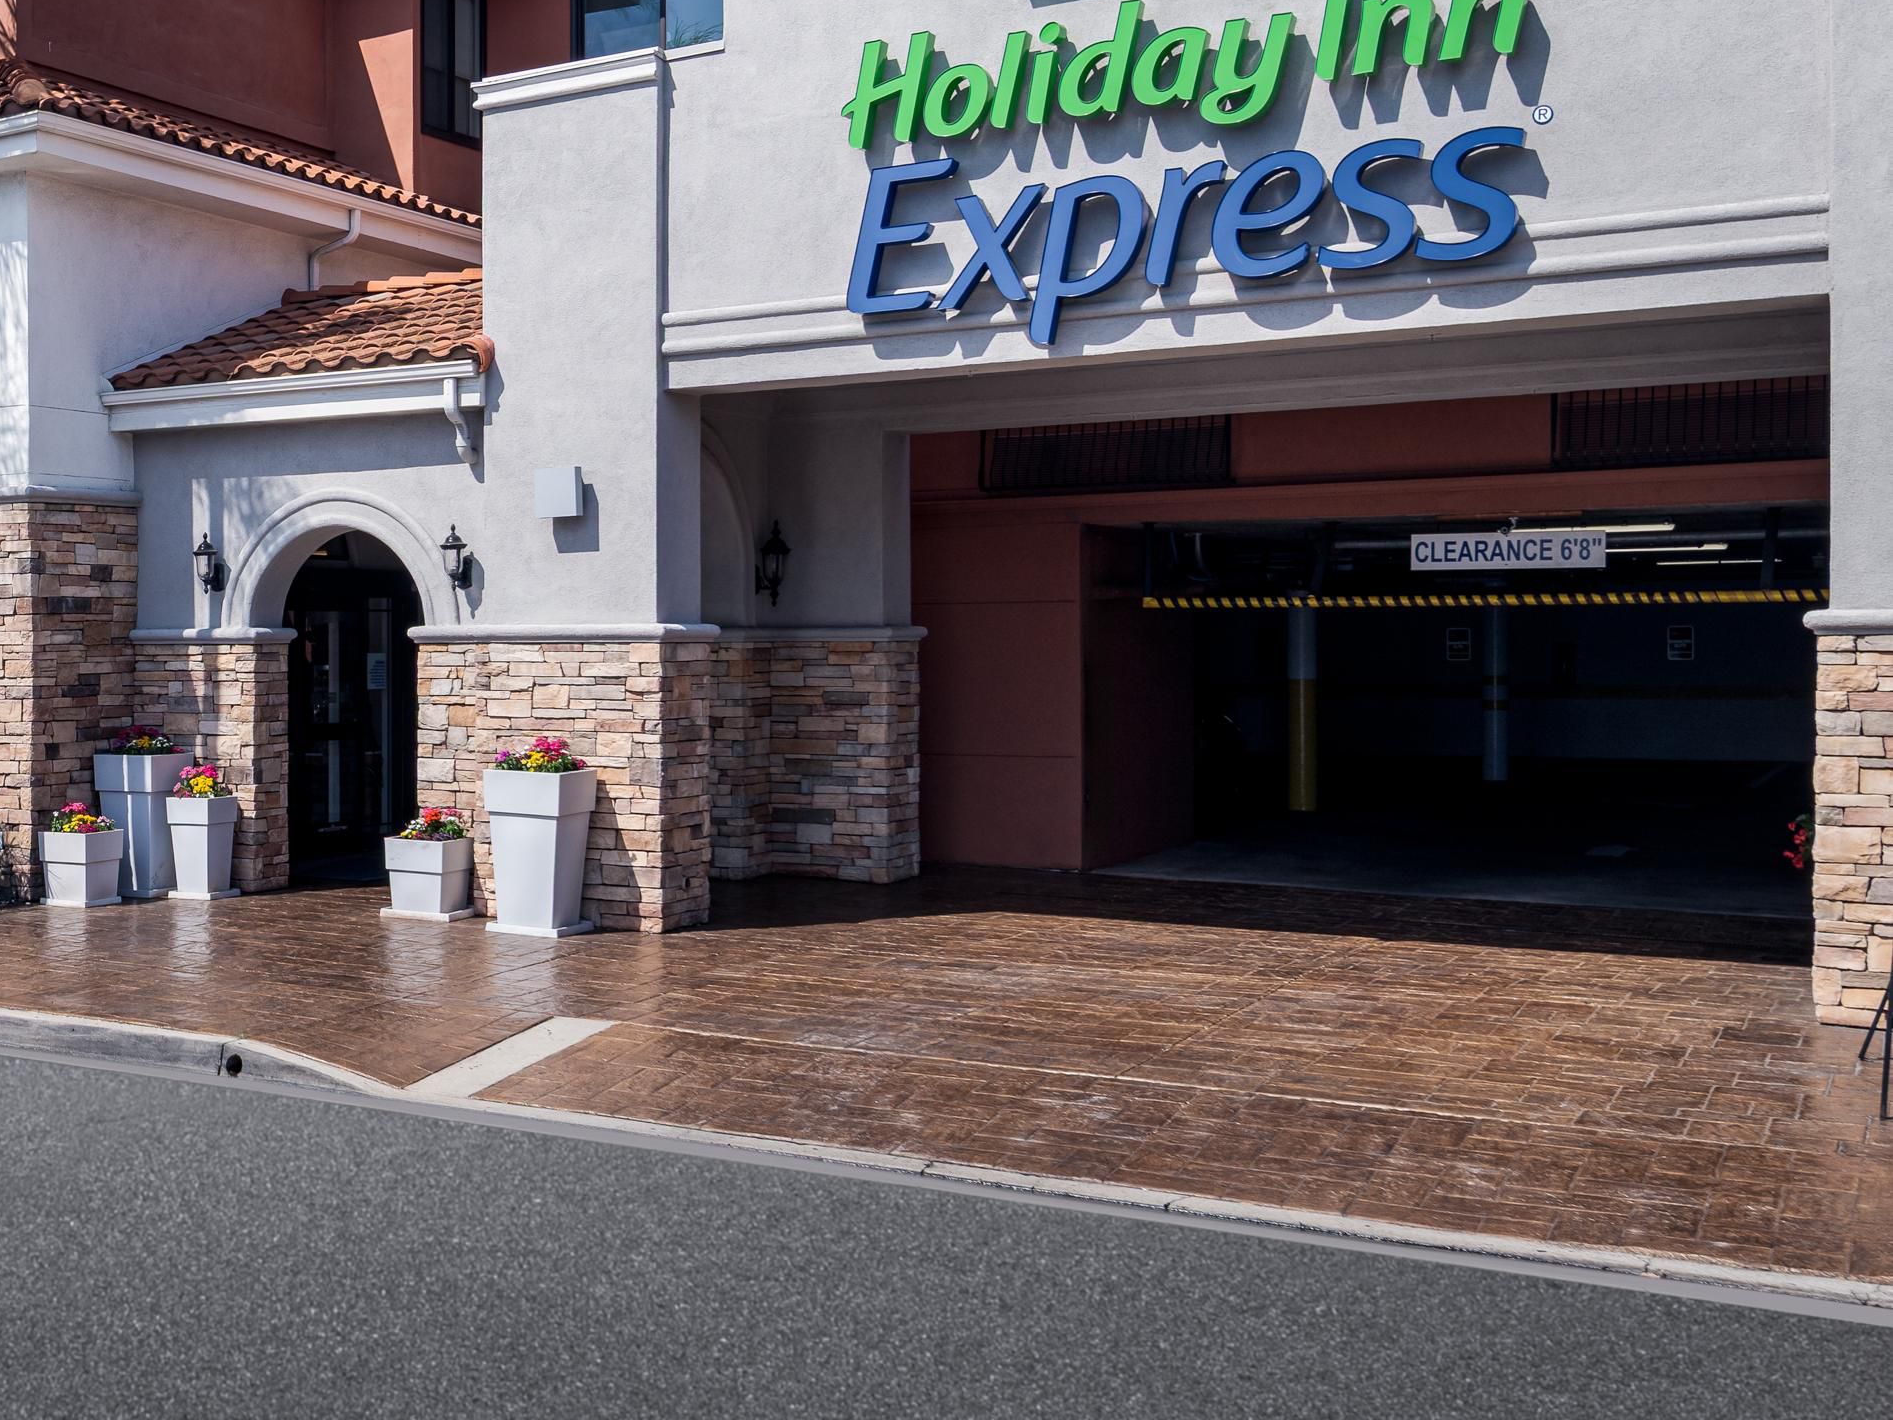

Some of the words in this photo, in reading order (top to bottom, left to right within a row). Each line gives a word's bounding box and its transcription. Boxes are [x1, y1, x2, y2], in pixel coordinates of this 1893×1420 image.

[845, 125, 1526, 347] Express
[1414, 539, 1553, 563] CLEARANCE
[1560, 537, 1603, 561] 6'8"
